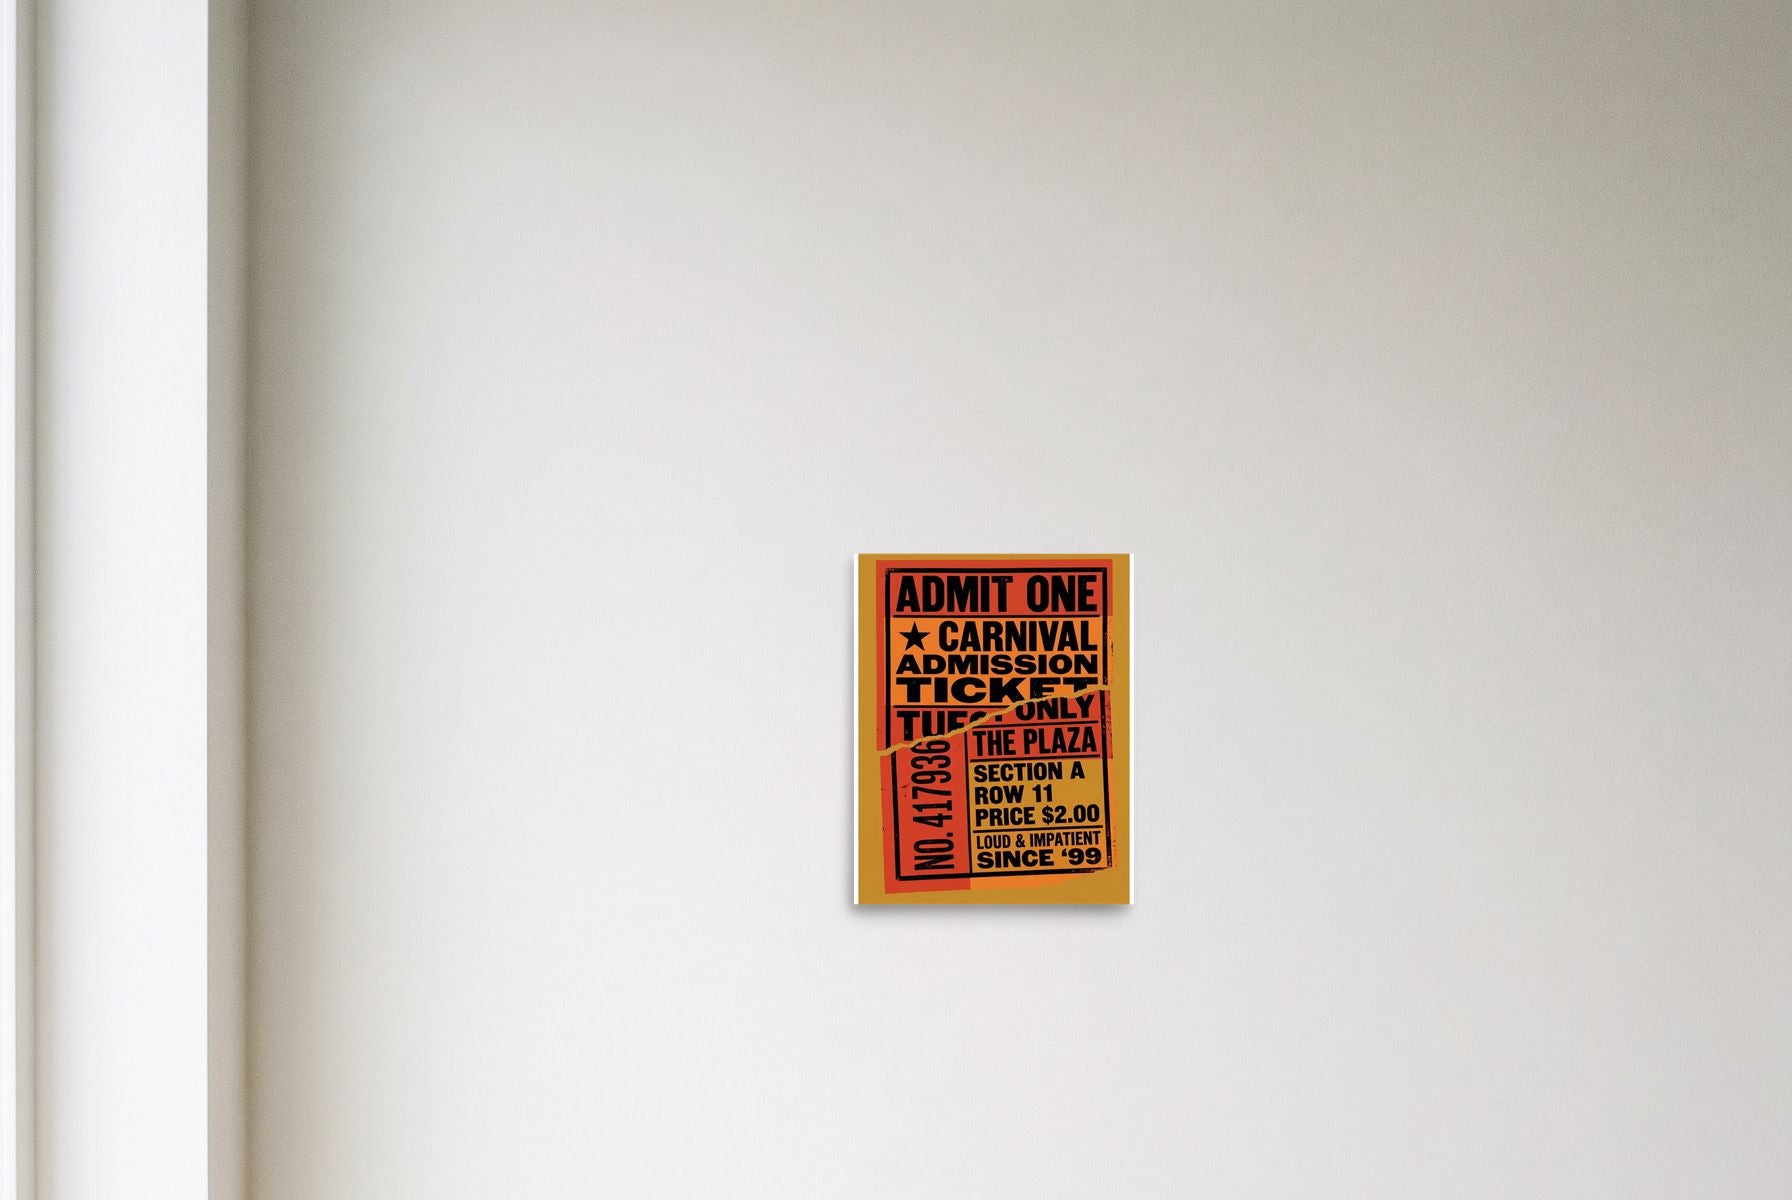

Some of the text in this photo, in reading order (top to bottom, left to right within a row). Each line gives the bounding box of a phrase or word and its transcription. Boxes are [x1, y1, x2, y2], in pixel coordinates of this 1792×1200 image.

[896, 575, 1098, 612] ADMIT ONE
[938, 621, 1098, 651] CARNIVAL
[896, 654, 1098, 675] ADMISSION
[896, 677, 1098, 703] TICKET
[1015, 694, 1095, 721] ONLY
[972, 726, 1098, 756] THE PLAZA
[973, 761, 1085, 783] SECTION A
[910, 740, 955, 871] NO. 417936
[975, 784, 1053, 805] ROW 11
[975, 804, 1100, 827] PRICE $2.00
[976, 831, 1101, 849] LOUD & IMPATIENT
[977, 849, 1055, 869] SINCE
